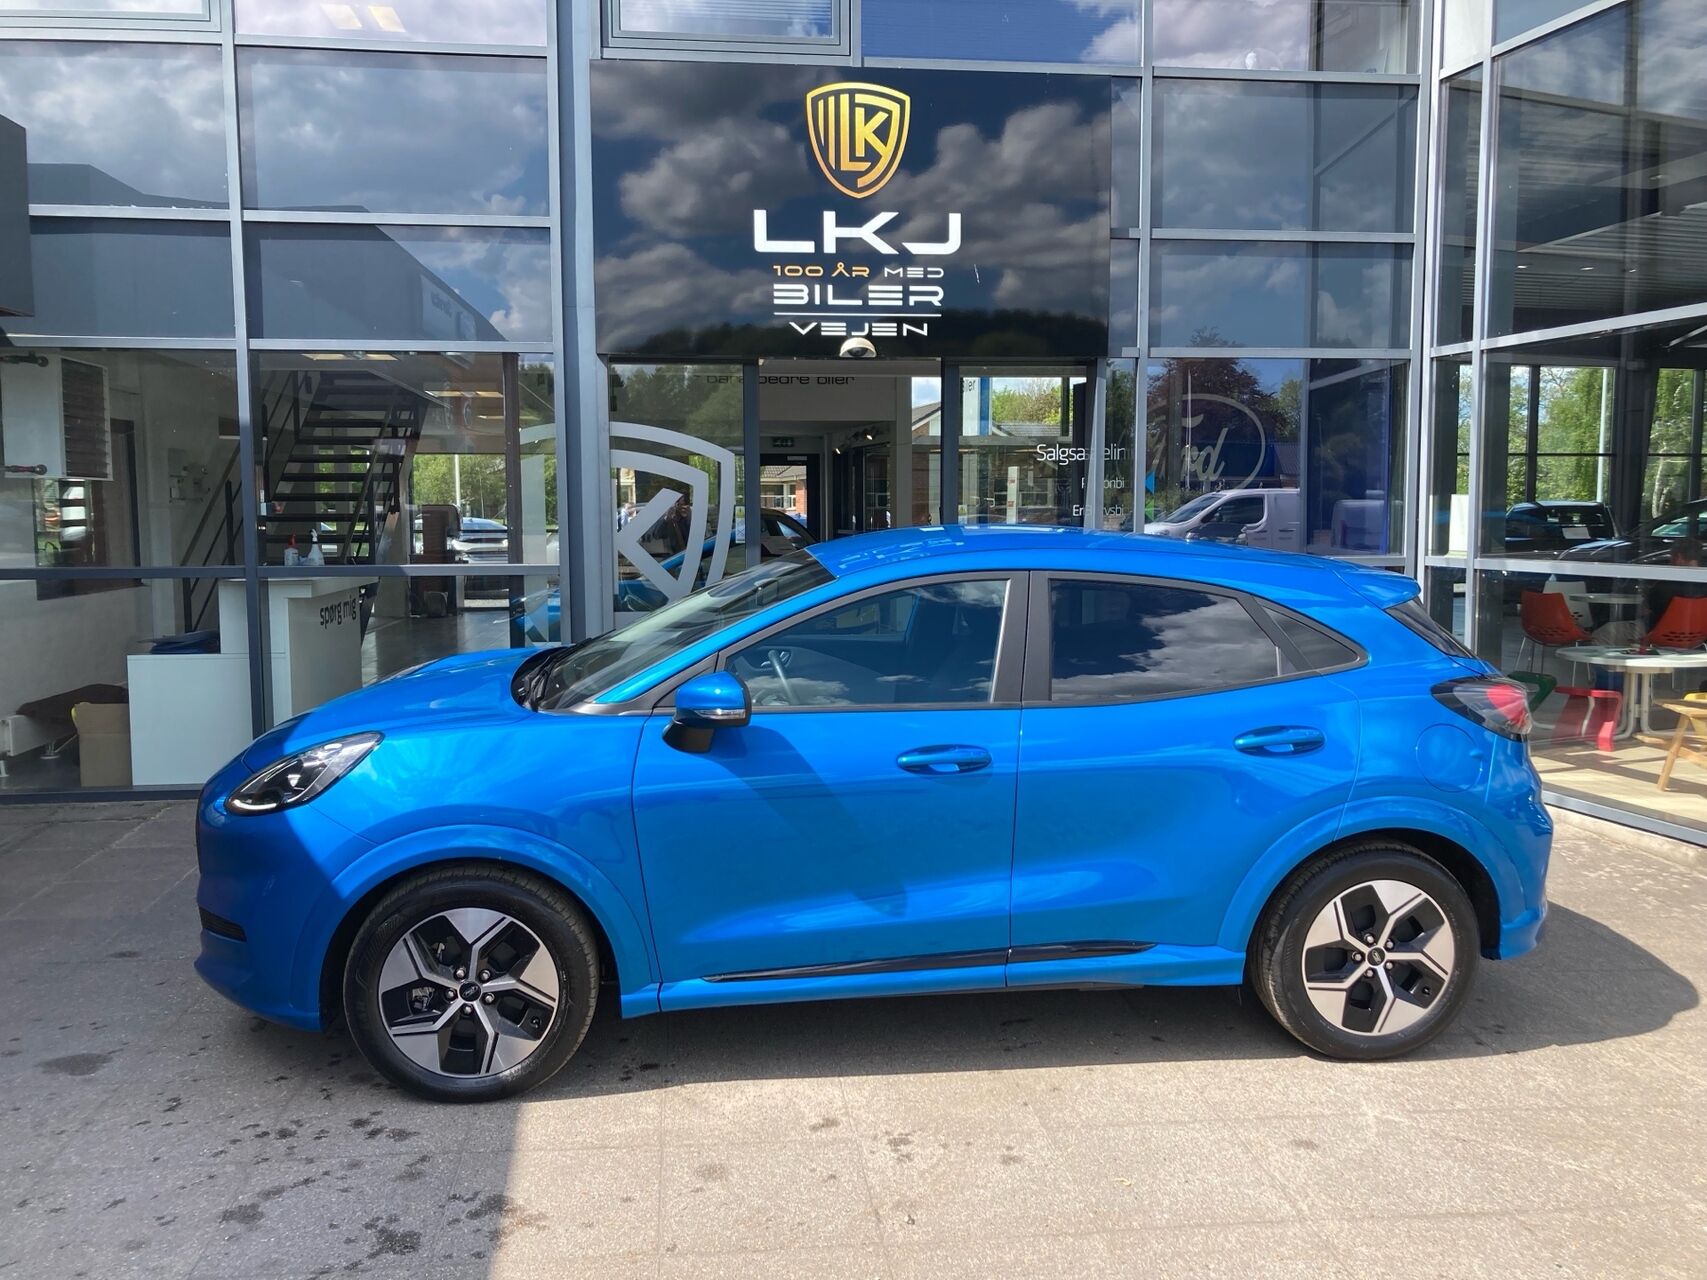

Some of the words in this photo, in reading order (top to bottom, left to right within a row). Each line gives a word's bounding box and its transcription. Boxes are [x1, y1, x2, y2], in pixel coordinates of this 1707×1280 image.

[753, 209, 962, 255] LKJ
[773, 265, 824, 277] 100
[831, 262, 870, 277] ÅR
[884, 267, 944, 278] MED
[773, 283, 944, 306] BILER
[789, 322, 928, 336] VEJEN
[343, 595, 357, 620] mig
